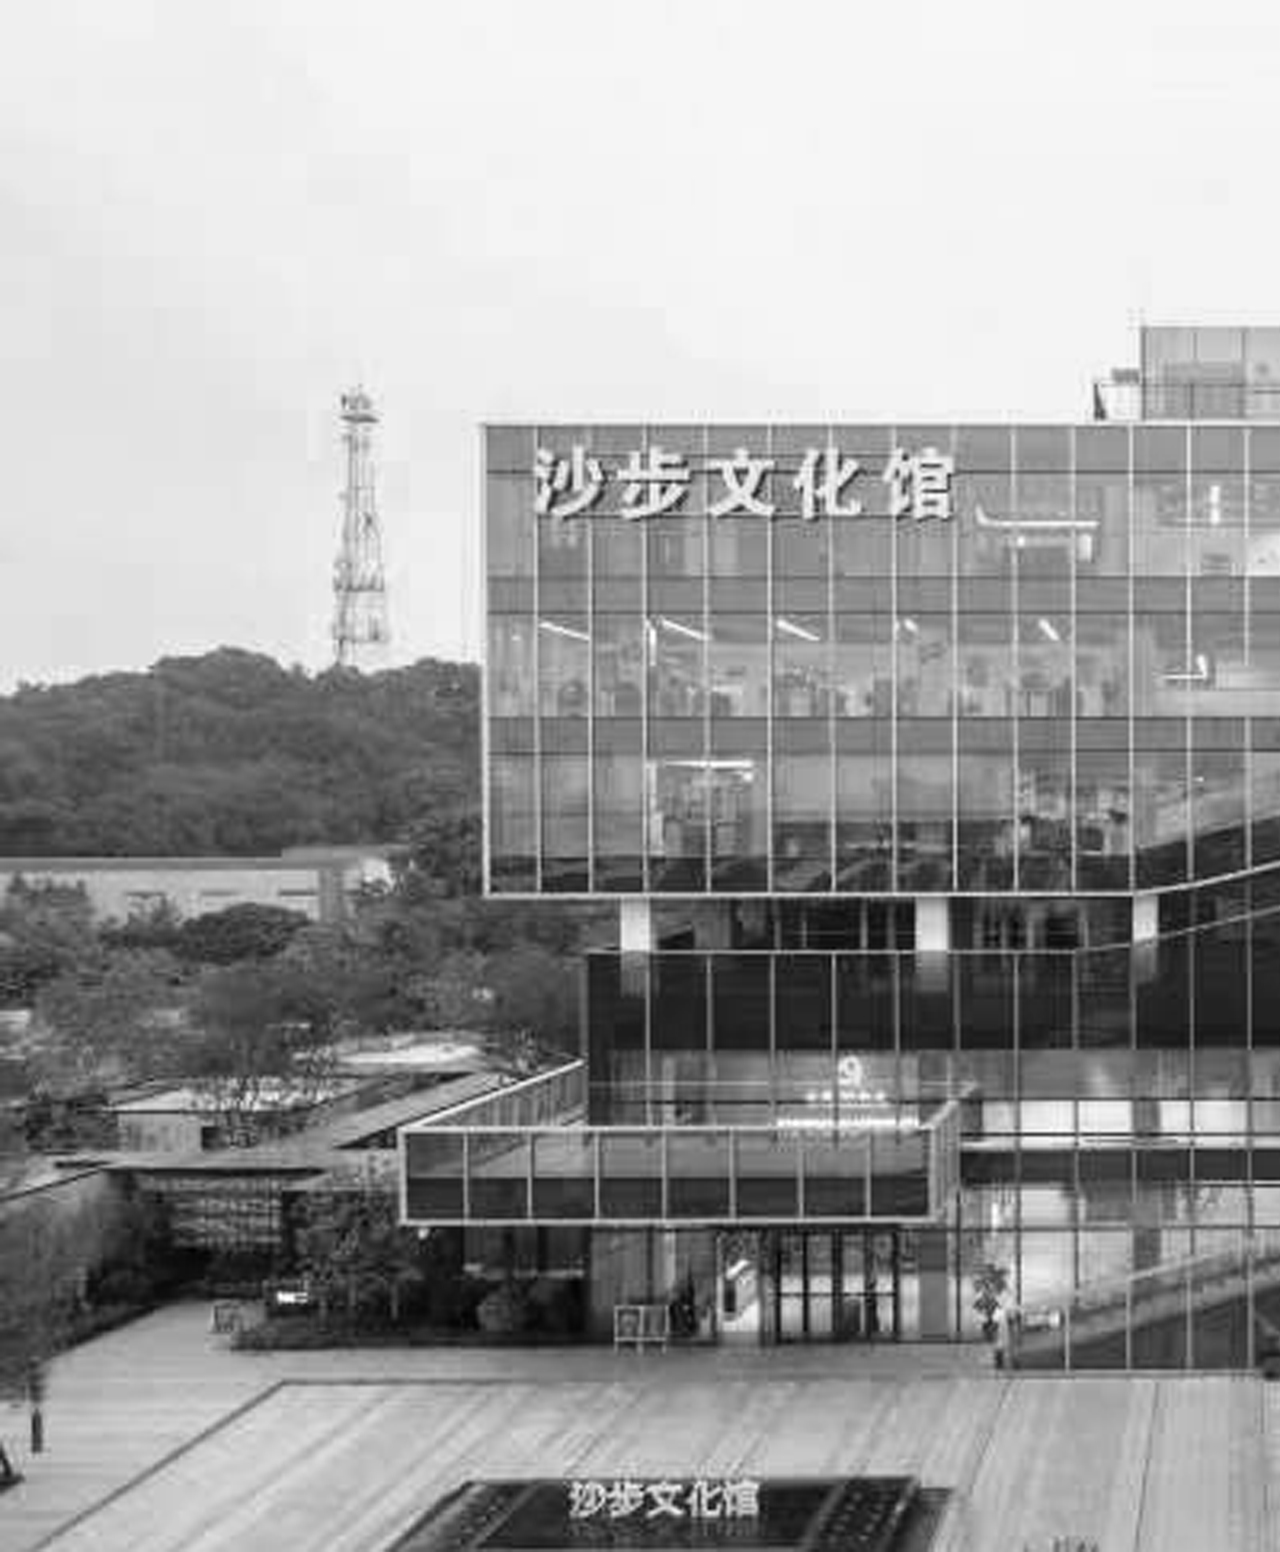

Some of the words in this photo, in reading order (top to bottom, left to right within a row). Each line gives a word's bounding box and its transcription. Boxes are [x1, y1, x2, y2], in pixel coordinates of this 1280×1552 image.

[534, 445, 955, 520] 沙步文化馆
[569, 1481, 760, 1518] 沙步文化馆
